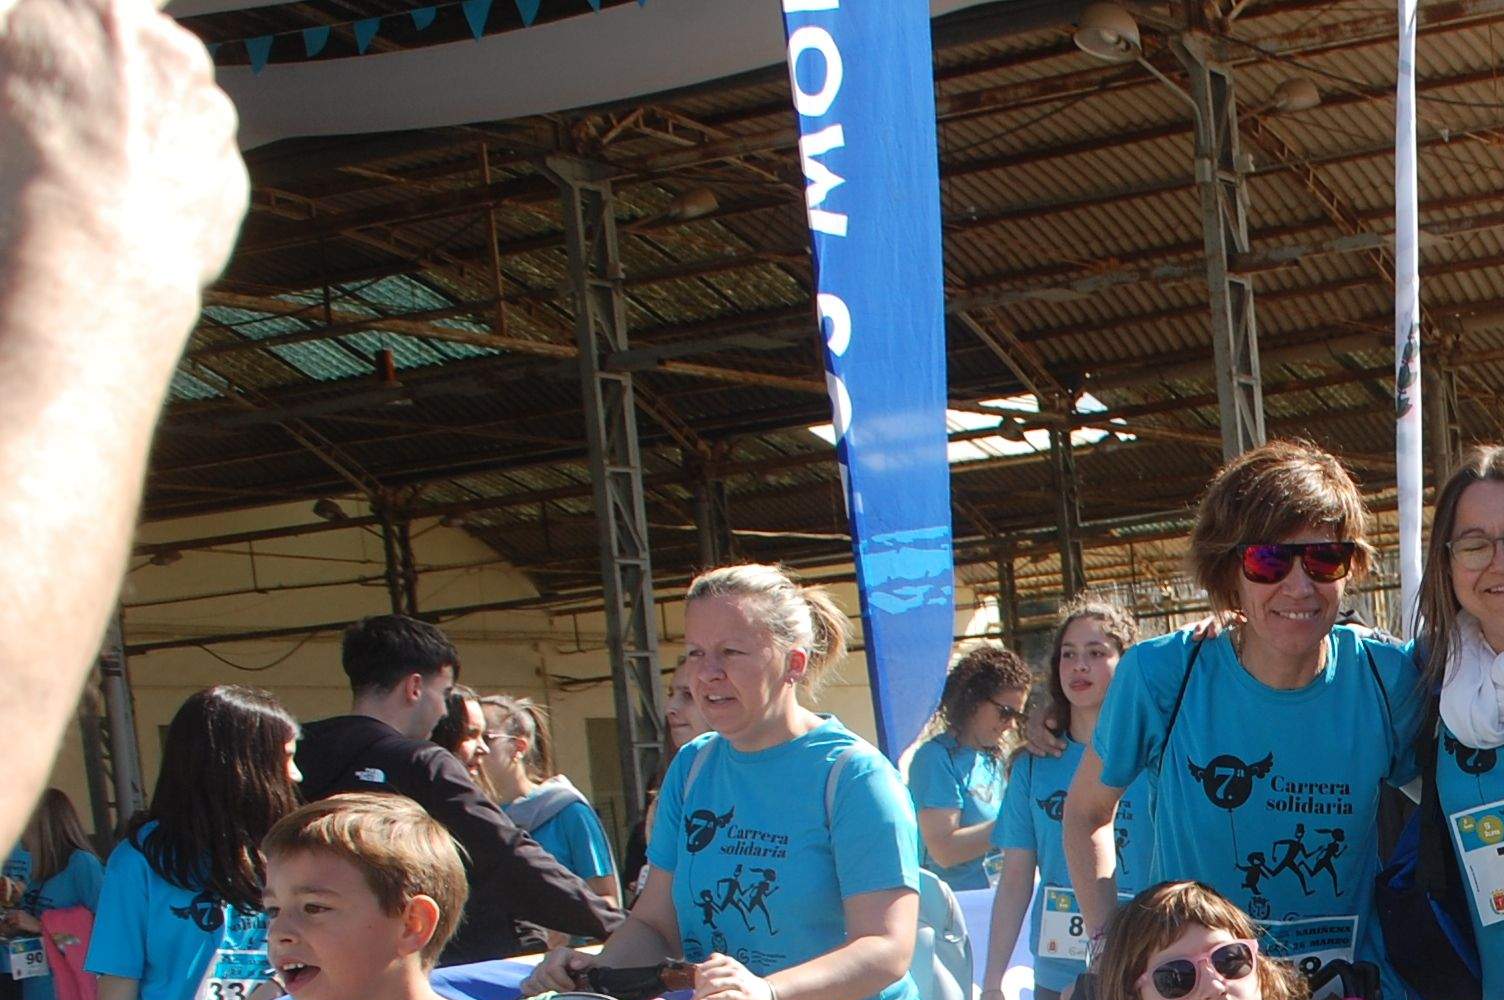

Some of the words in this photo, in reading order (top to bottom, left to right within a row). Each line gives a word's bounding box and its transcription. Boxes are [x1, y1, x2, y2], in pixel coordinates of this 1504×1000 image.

[1270, 774, 1351, 797] Carrera
[1265, 796, 1354, 816] solidaria
[726, 823, 790, 845] Carrera
[720, 840, 787, 859] solidaria
